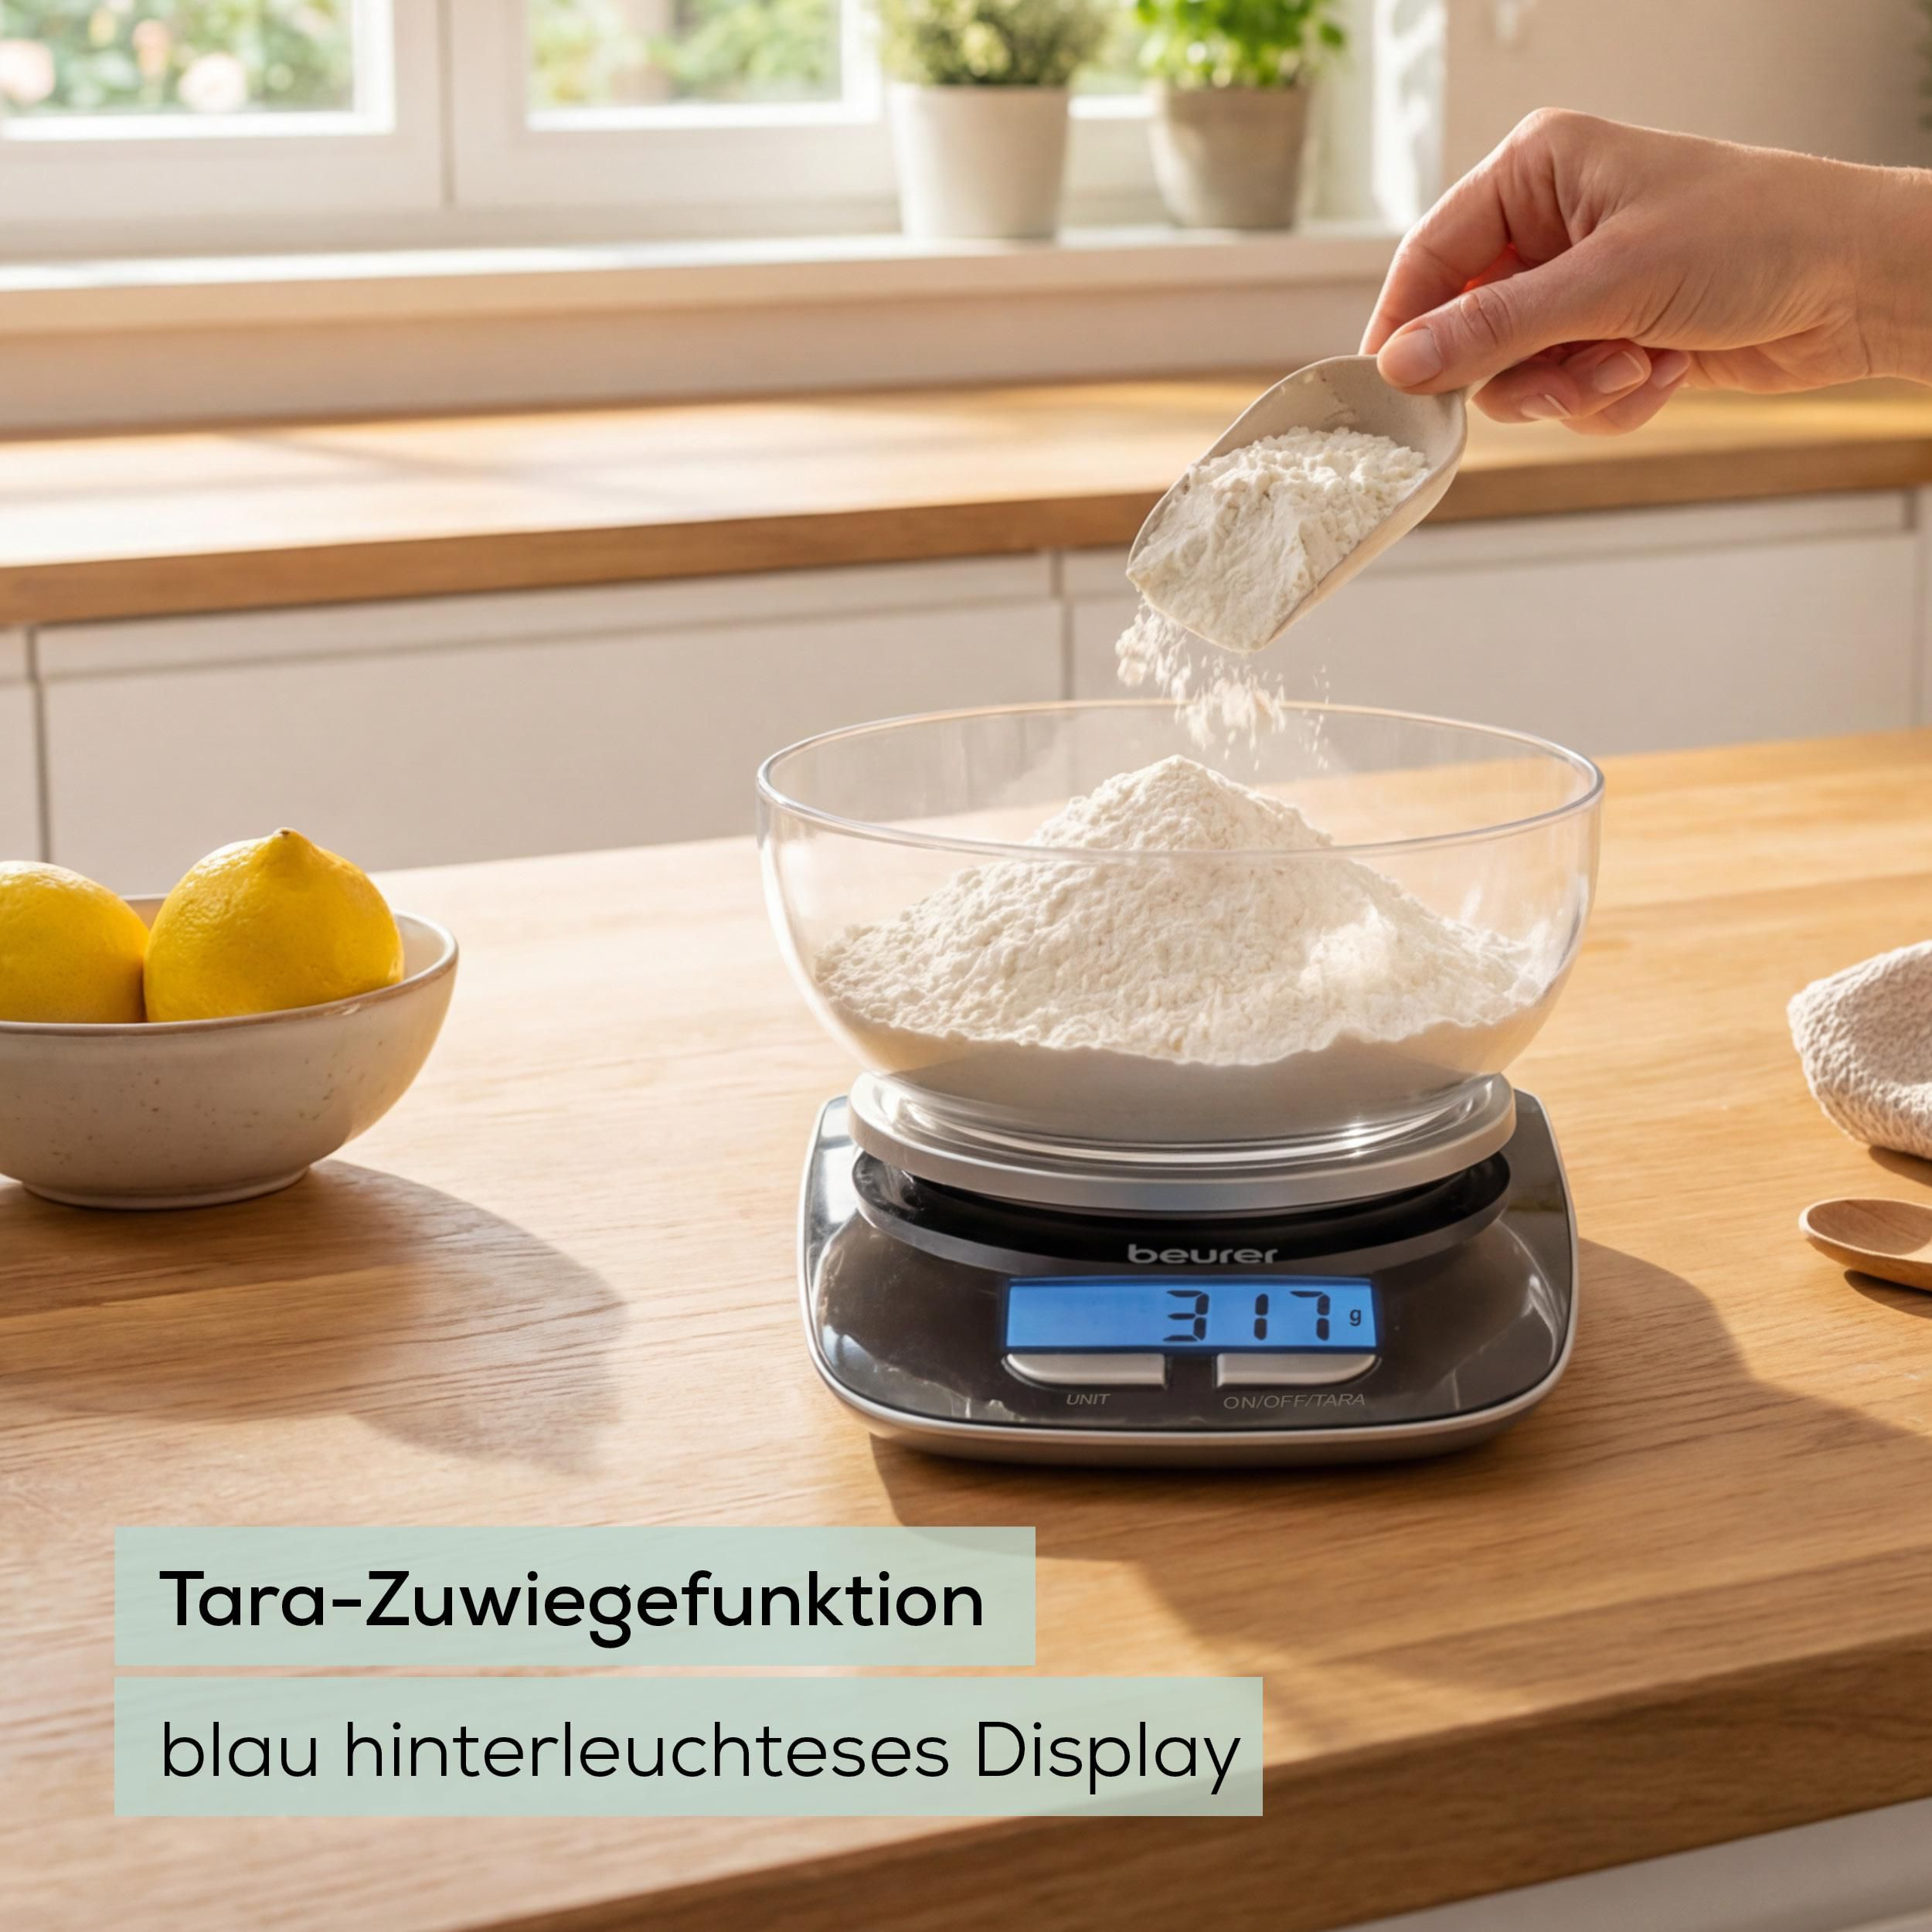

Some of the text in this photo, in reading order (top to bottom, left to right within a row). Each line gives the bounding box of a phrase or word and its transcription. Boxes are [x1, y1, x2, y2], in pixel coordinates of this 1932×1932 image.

[1128, 1243, 1278, 1264] beurer
[1163, 1290, 1362, 1342] 317 g
[1066, 1393, 1111, 1405] UNIT
[1223, 1393, 1366, 1410] ON/OFF/TARA
